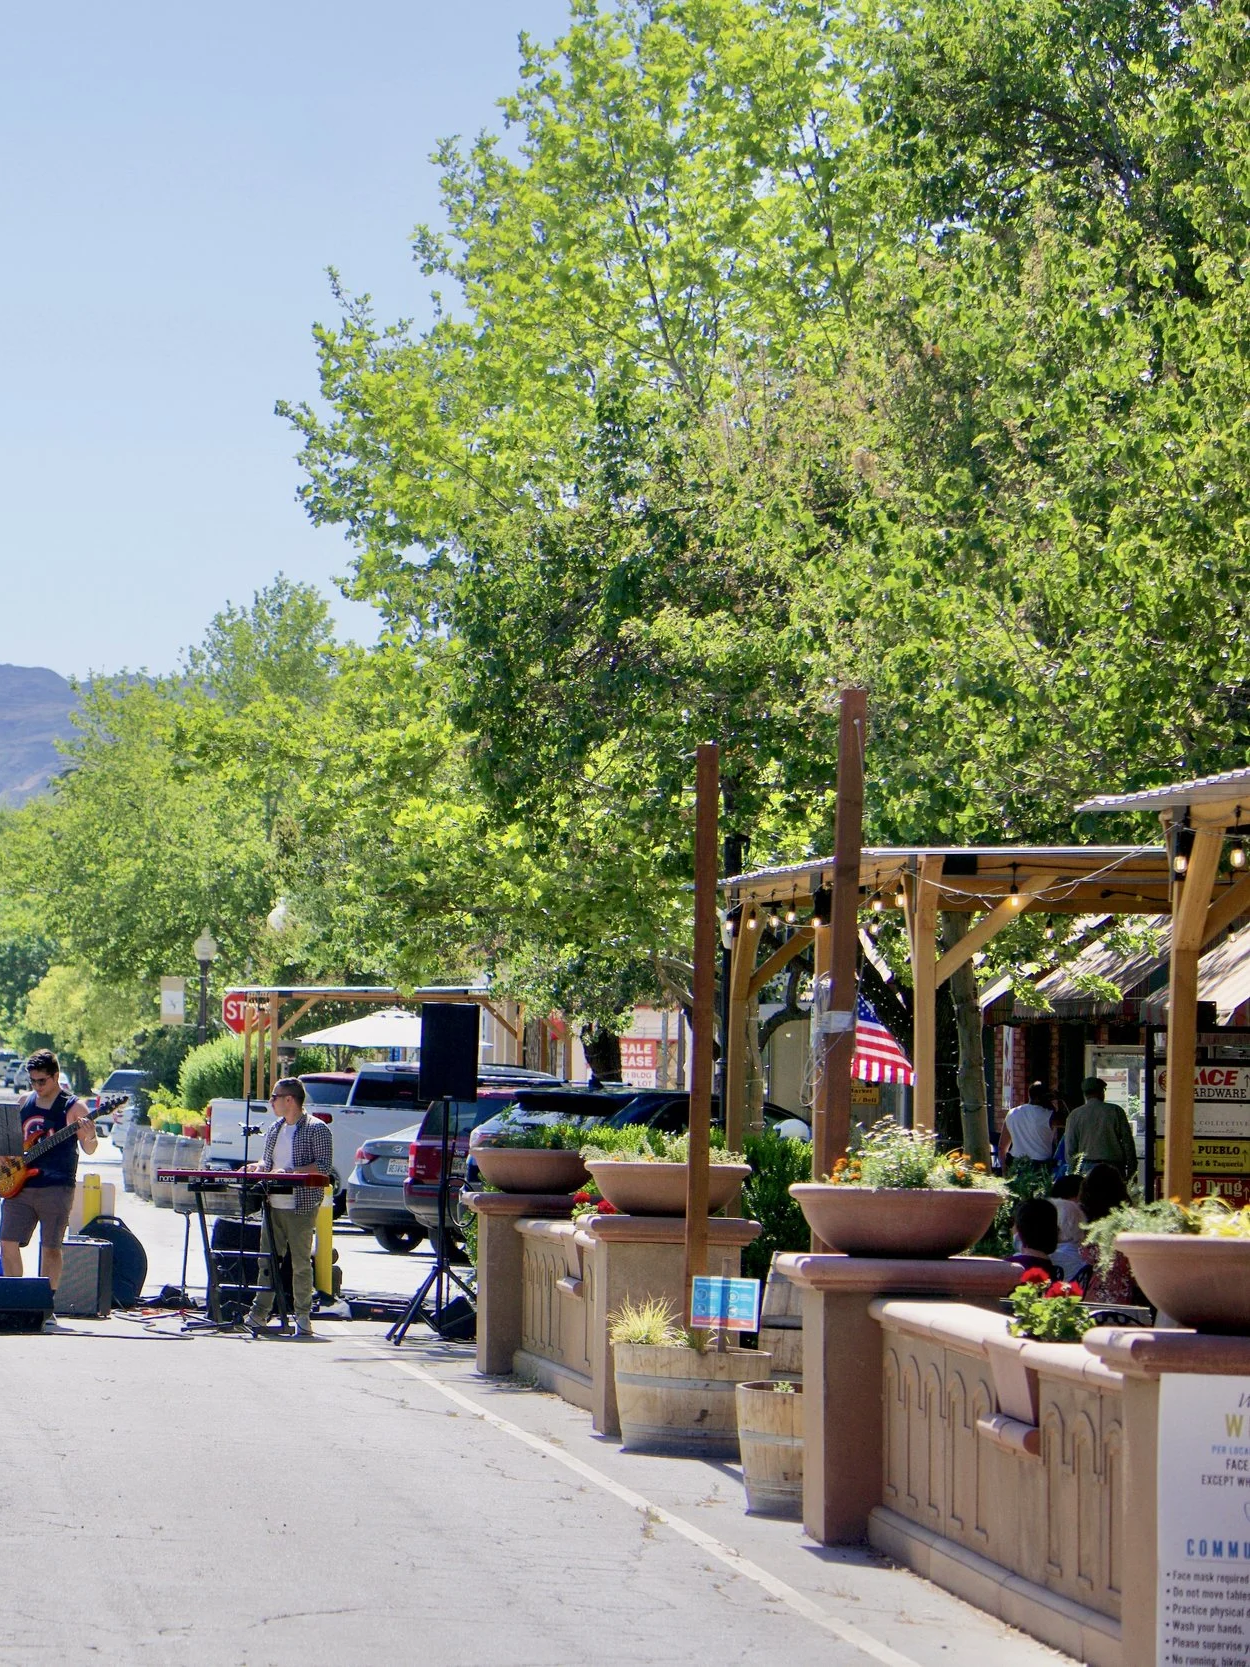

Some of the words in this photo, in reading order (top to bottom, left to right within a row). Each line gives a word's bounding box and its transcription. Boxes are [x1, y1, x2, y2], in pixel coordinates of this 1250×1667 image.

[620, 1043, 652, 1055] SALE
[621, 1055, 653, 1067] EASE
[1194, 1068, 1239, 1086] ACE
[1194, 1088, 1247, 1098] ARDWARE
[1198, 1145, 1240, 1155] PUEBLO
[1213, 1160, 1244, 1168] Taqueria
[158, 1175, 176, 1183] nord
[1206, 1180, 1243, 1198] Drug
[1230, 1446, 1250, 1456] LOCA
[1226, 1458, 1249, 1471] FACE
[1201, 1474, 1234, 1486] EXCEPT
[1186, 1538, 1250, 1559] COMMU
[1172, 1571, 1191, 1580] Face
[1193, 1572, 1215, 1582] mask
[1216, 1574, 1249, 1585] required
[1172, 1586, 1184, 1597] Do
[1186, 1588, 1200, 1598] not
[1202, 1591, 1223, 1600] move
[1172, 1603, 1208, 1616] Practice
[1210, 1605, 1244, 1619] physical
[1172, 1621, 1194, 1632] Wash
[1197, 1623, 1215, 1635] your
[1217, 1623, 1245, 1636] hands.
[1172, 1637, 1200, 1649] Please
[1202, 1640, 1242, 1652] supervise
[1172, 1654, 1184, 1665] No
